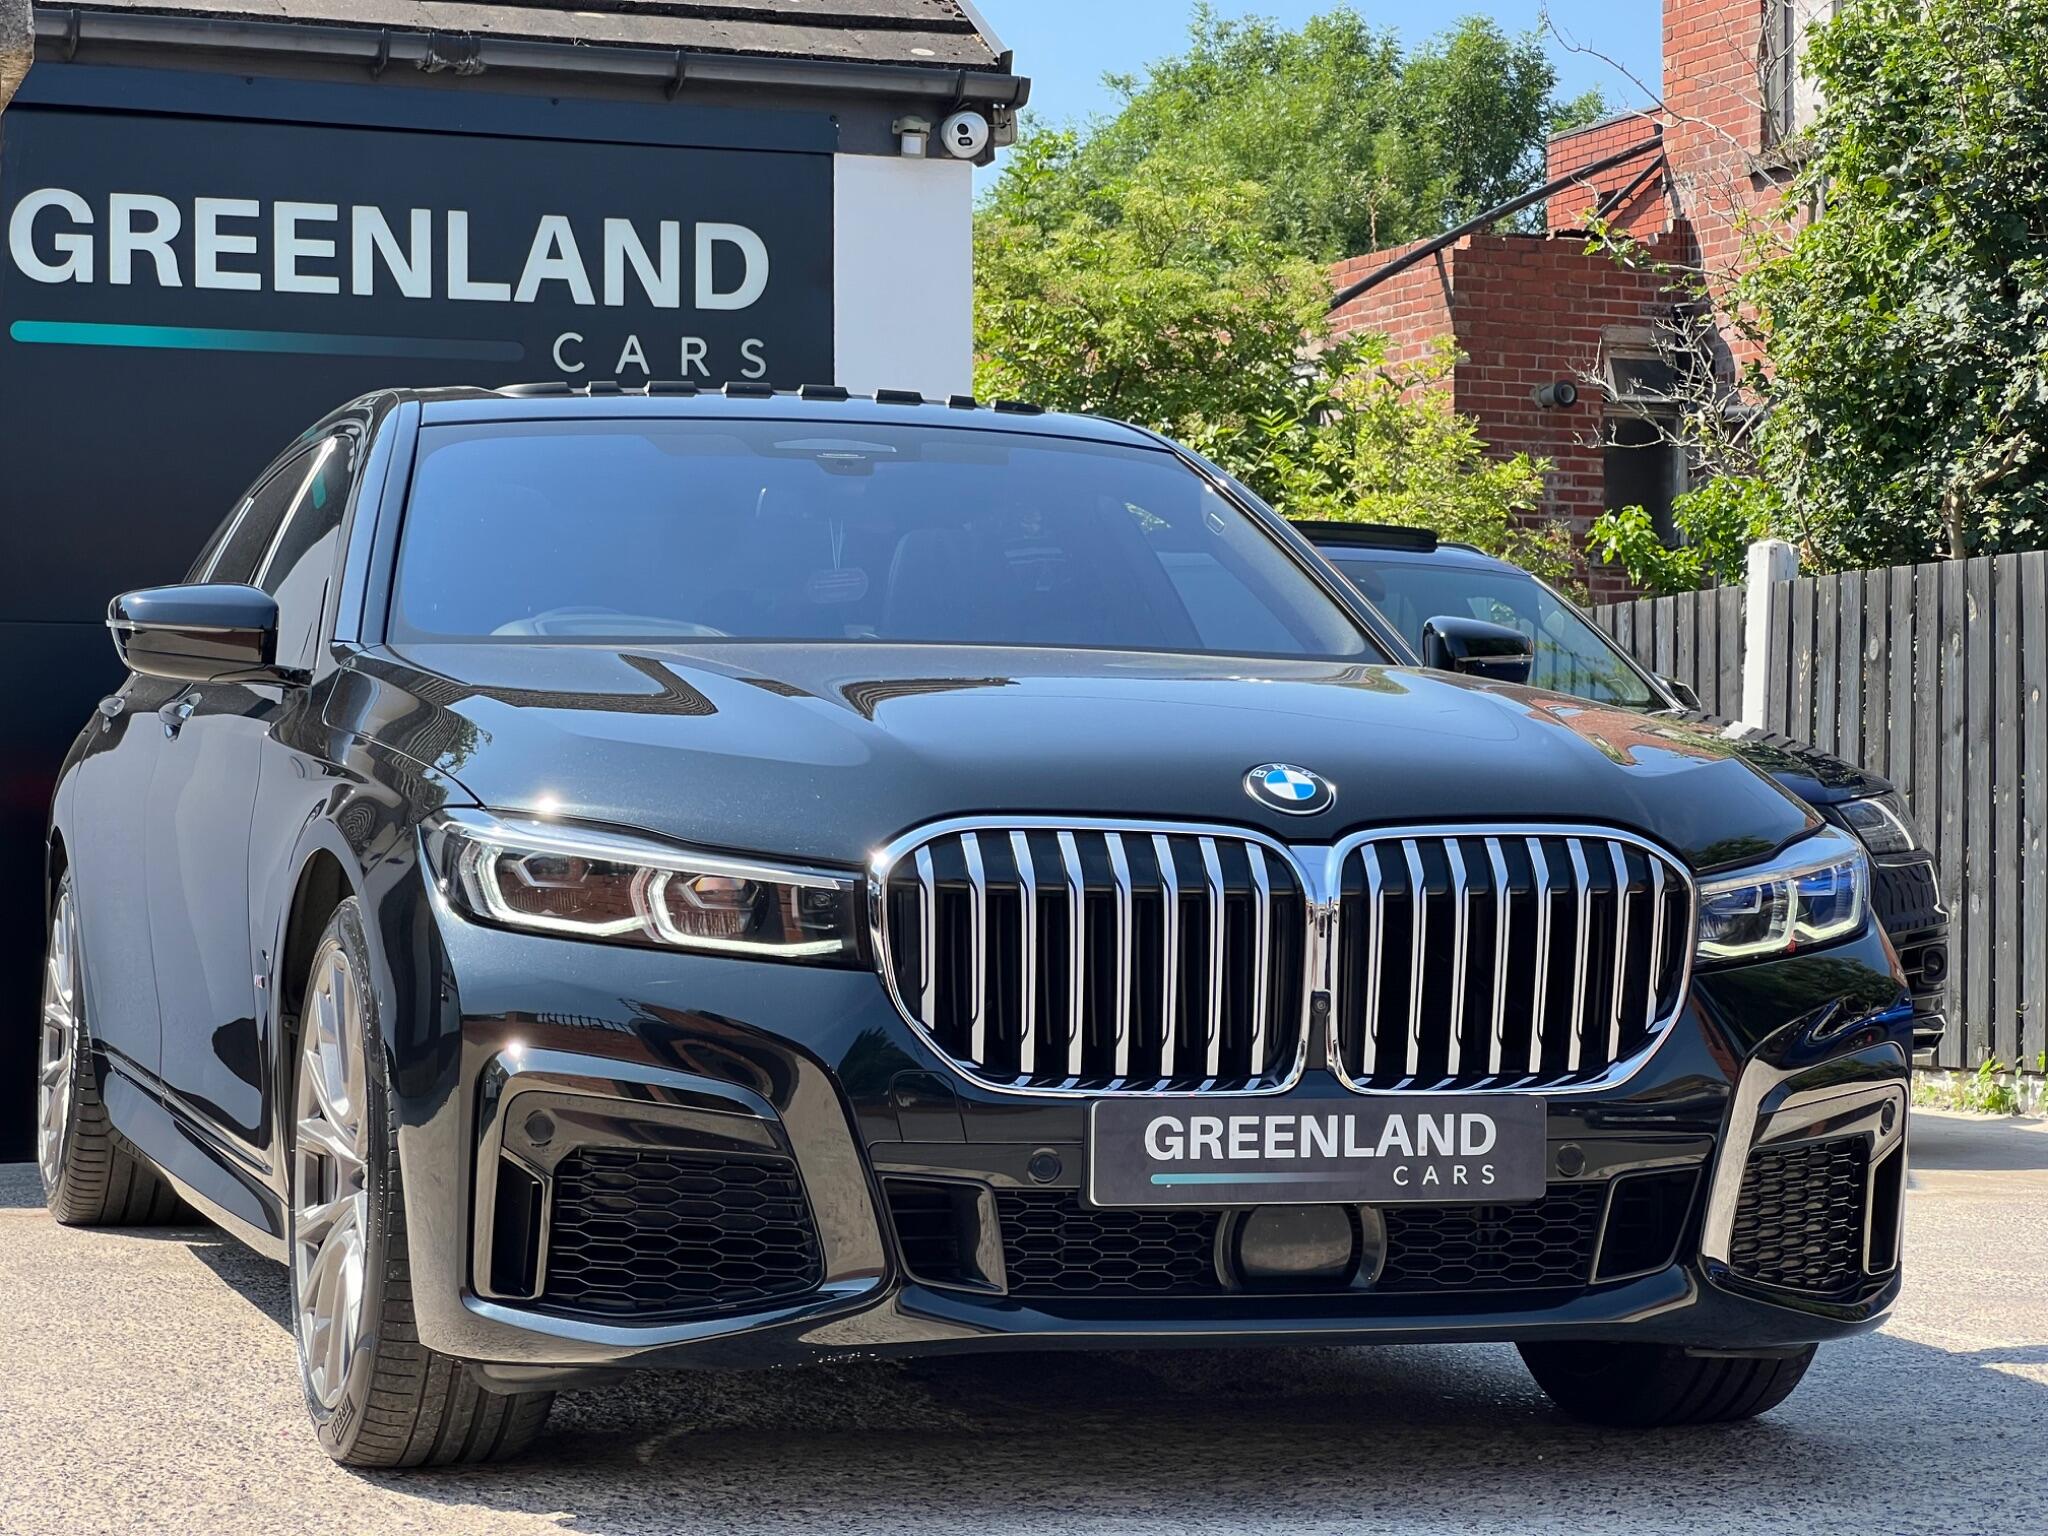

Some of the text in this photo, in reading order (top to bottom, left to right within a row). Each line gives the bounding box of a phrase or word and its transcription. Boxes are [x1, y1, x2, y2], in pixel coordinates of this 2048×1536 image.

[8, 188, 770, 310] GREENLAND
[552, 331, 768, 379] CARS
[1252, 763, 1317, 778] BMW
[1144, 1113, 1497, 1161] GREENLAND
[1393, 1164, 1496, 1186] CARS
[331, 1392, 357, 1446] PIRELLI
